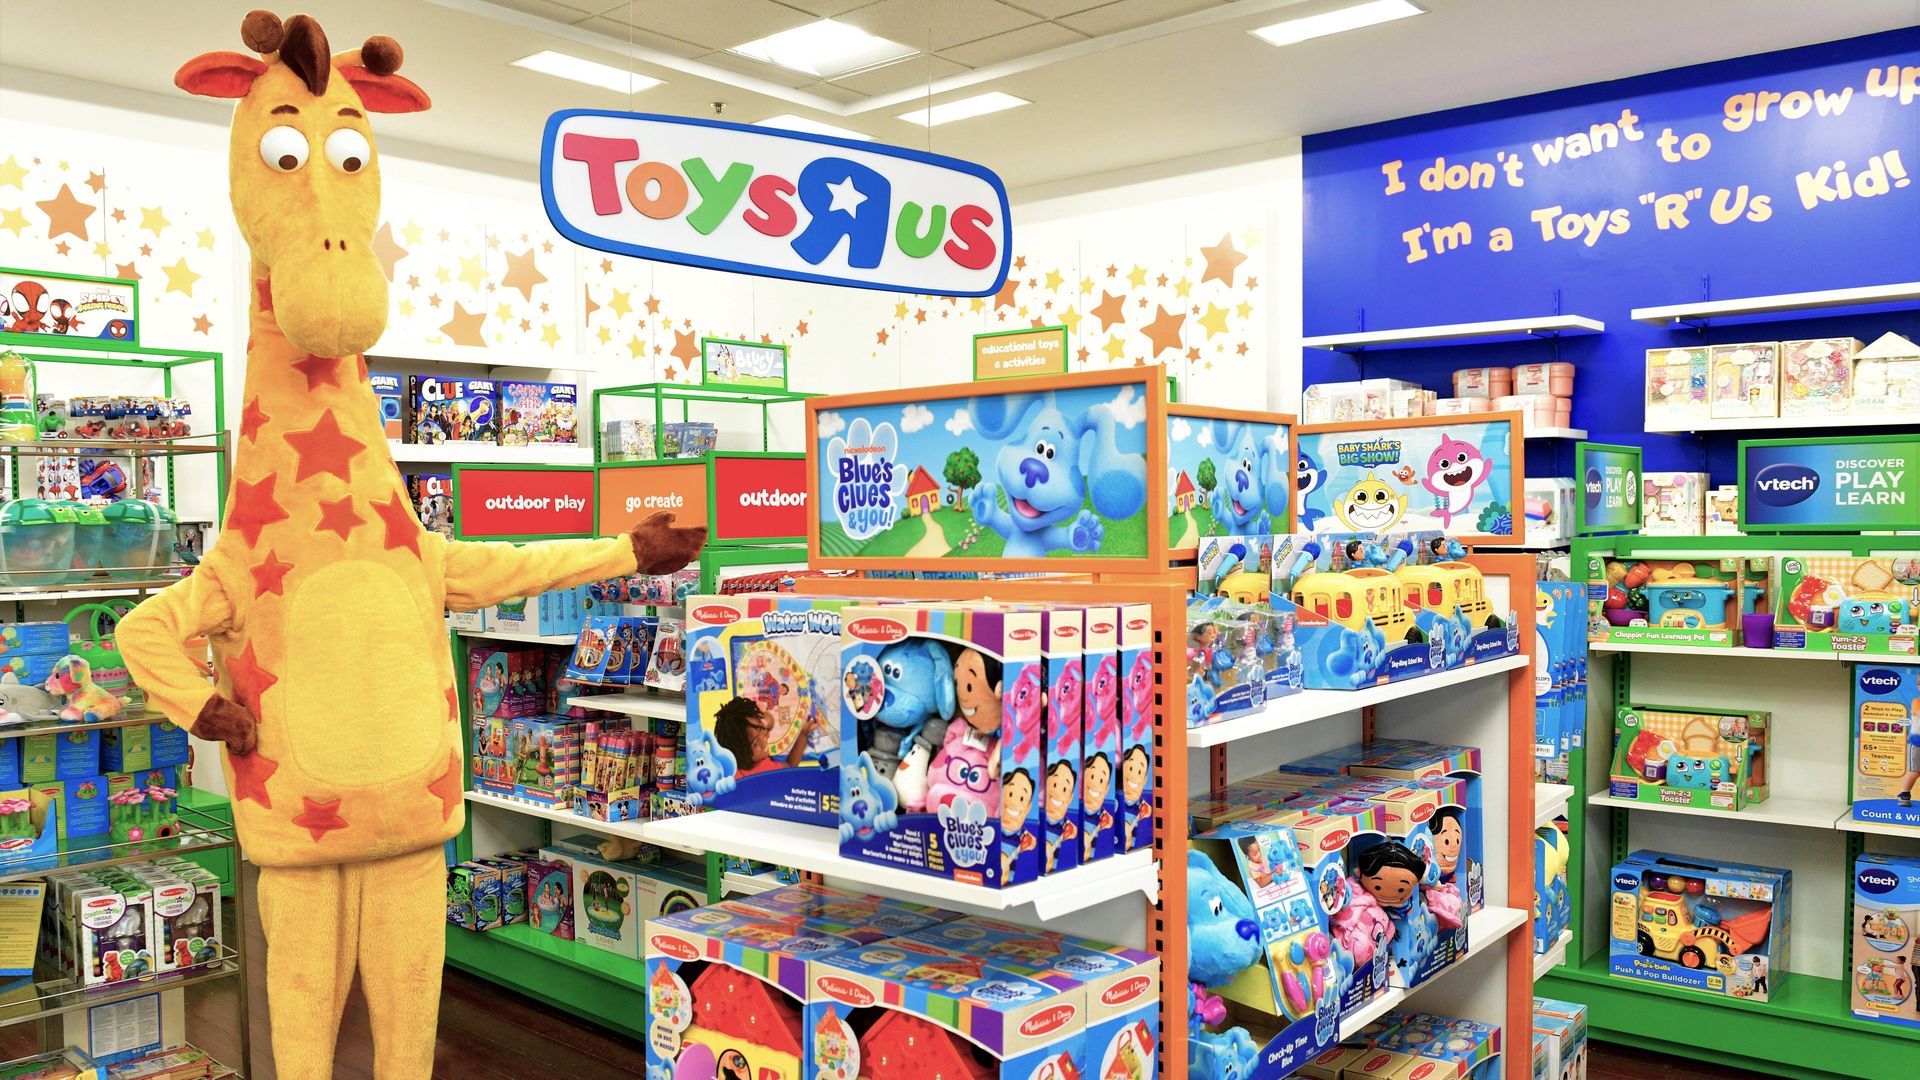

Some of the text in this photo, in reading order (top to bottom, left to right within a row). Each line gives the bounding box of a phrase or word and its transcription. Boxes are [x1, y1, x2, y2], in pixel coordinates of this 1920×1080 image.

[1382, 65, 1920, 195] I don't want to grow up
[1402, 149, 1911, 263] I'm a Toys "R" Us Kid!
[982, 339, 1059, 355] educational toys
[1003, 355, 1046, 368] activities
[371, 376, 399, 387] GIANT
[468, 381, 494, 391] GIANT
[422, 378, 464, 402] CLUE
[551, 386, 575, 395] GIANT
[844, 445, 887, 454] nickelodeon
[1338, 440, 1400, 454] BABY SHARK'S
[1340, 451, 1399, 465] BIG SHOW!
[1836, 458, 1905, 469] DISCOVER
[838, 455, 894, 484] Blue's
[426, 477, 453, 495] CLU
[1606, 478, 1622, 492] PLAY
[1757, 476, 1814, 491] vtech
[1835, 471, 1905, 489] PLAY
[485, 494, 586, 512] outdoor play
[625, 493, 683, 512] go create
[739, 488, 807, 507] outdoor
[838, 483, 891, 513] Clues
[1606, 496, 1622, 508] LEARN
[1835, 491, 1905, 505] LEARN
[763, 613, 806, 634] Water
[852, 623, 880, 636] Melissa
[1646, 632, 1659, 640] Fun
[1661, 633, 1691, 641] Learning
[1830, 635, 1867, 643] Yum-2-3
[1831, 642, 1866, 651] Toaster
[1862, 677, 1898, 686] vtech
[1660, 788, 1692, 797] Yum-2-3
[822, 794, 830, 811] 5
[1661, 796, 1691, 804] Toaster
[1861, 809, 1892, 820] Count
[1906, 814, 1920, 822] Wi
[946, 817, 984, 836] Blue's
[889, 832, 903, 840] Finger
[929, 833, 938, 849] 5
[947, 834, 983, 850] Clues
[1615, 877, 1638, 886] vtech
[1860, 875, 1896, 887] vtech
[1366, 974, 1371, 986] 5
[1615, 965, 1634, 974] Push
[1643, 970, 1659, 980] Pop
[1662, 974, 1702, 985] Bulldozer
[1106, 989, 1130, 1002] Melissa
[1024, 1018, 1052, 1033] Melissa
[1268, 1036, 1308, 1064] Check-Up Time
[1281, 1055, 1294, 1068] Blue
